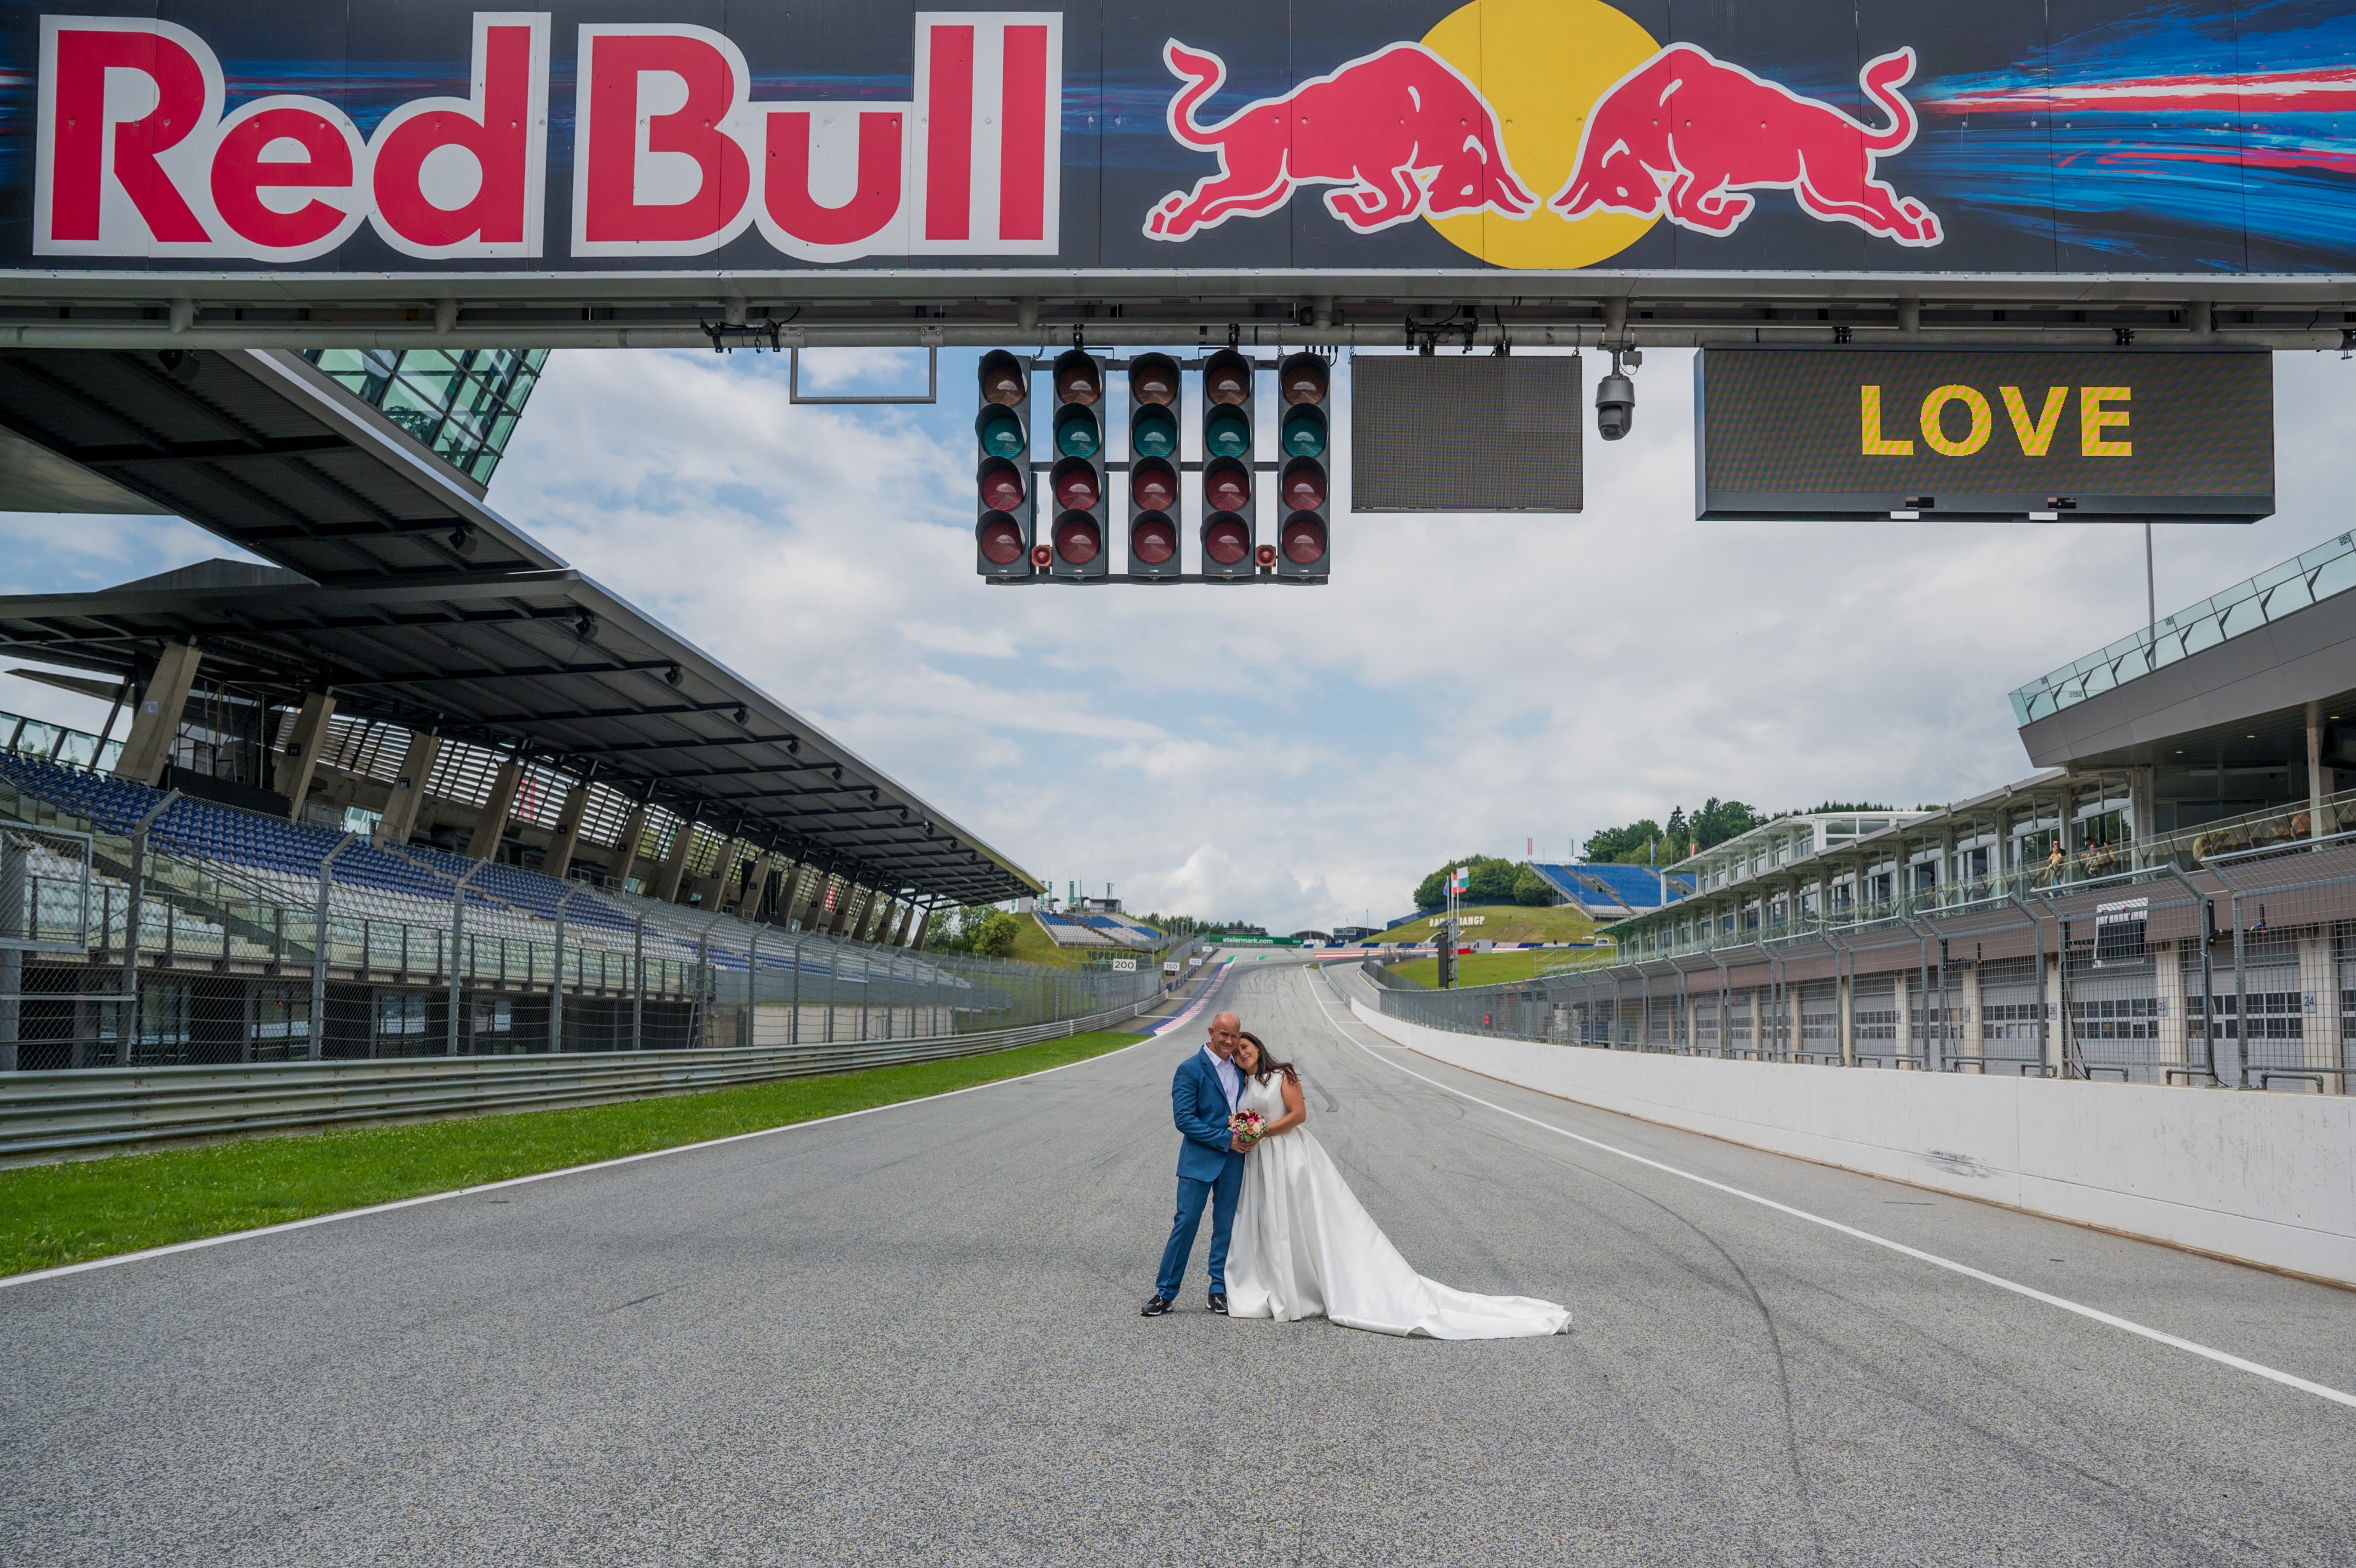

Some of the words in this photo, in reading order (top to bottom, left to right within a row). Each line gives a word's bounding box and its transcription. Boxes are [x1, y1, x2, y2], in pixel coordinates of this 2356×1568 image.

[46, 20, 537, 253] Red
[579, 19, 1055, 253] Bull
[1861, 384, 2132, 457] LOVE
[1429, 916, 1485, 927] #AIANGP
[1114, 961, 1134, 969] 200
[2304, 996, 2315, 1006] 24
[2159, 1002, 2166, 1011] 25
